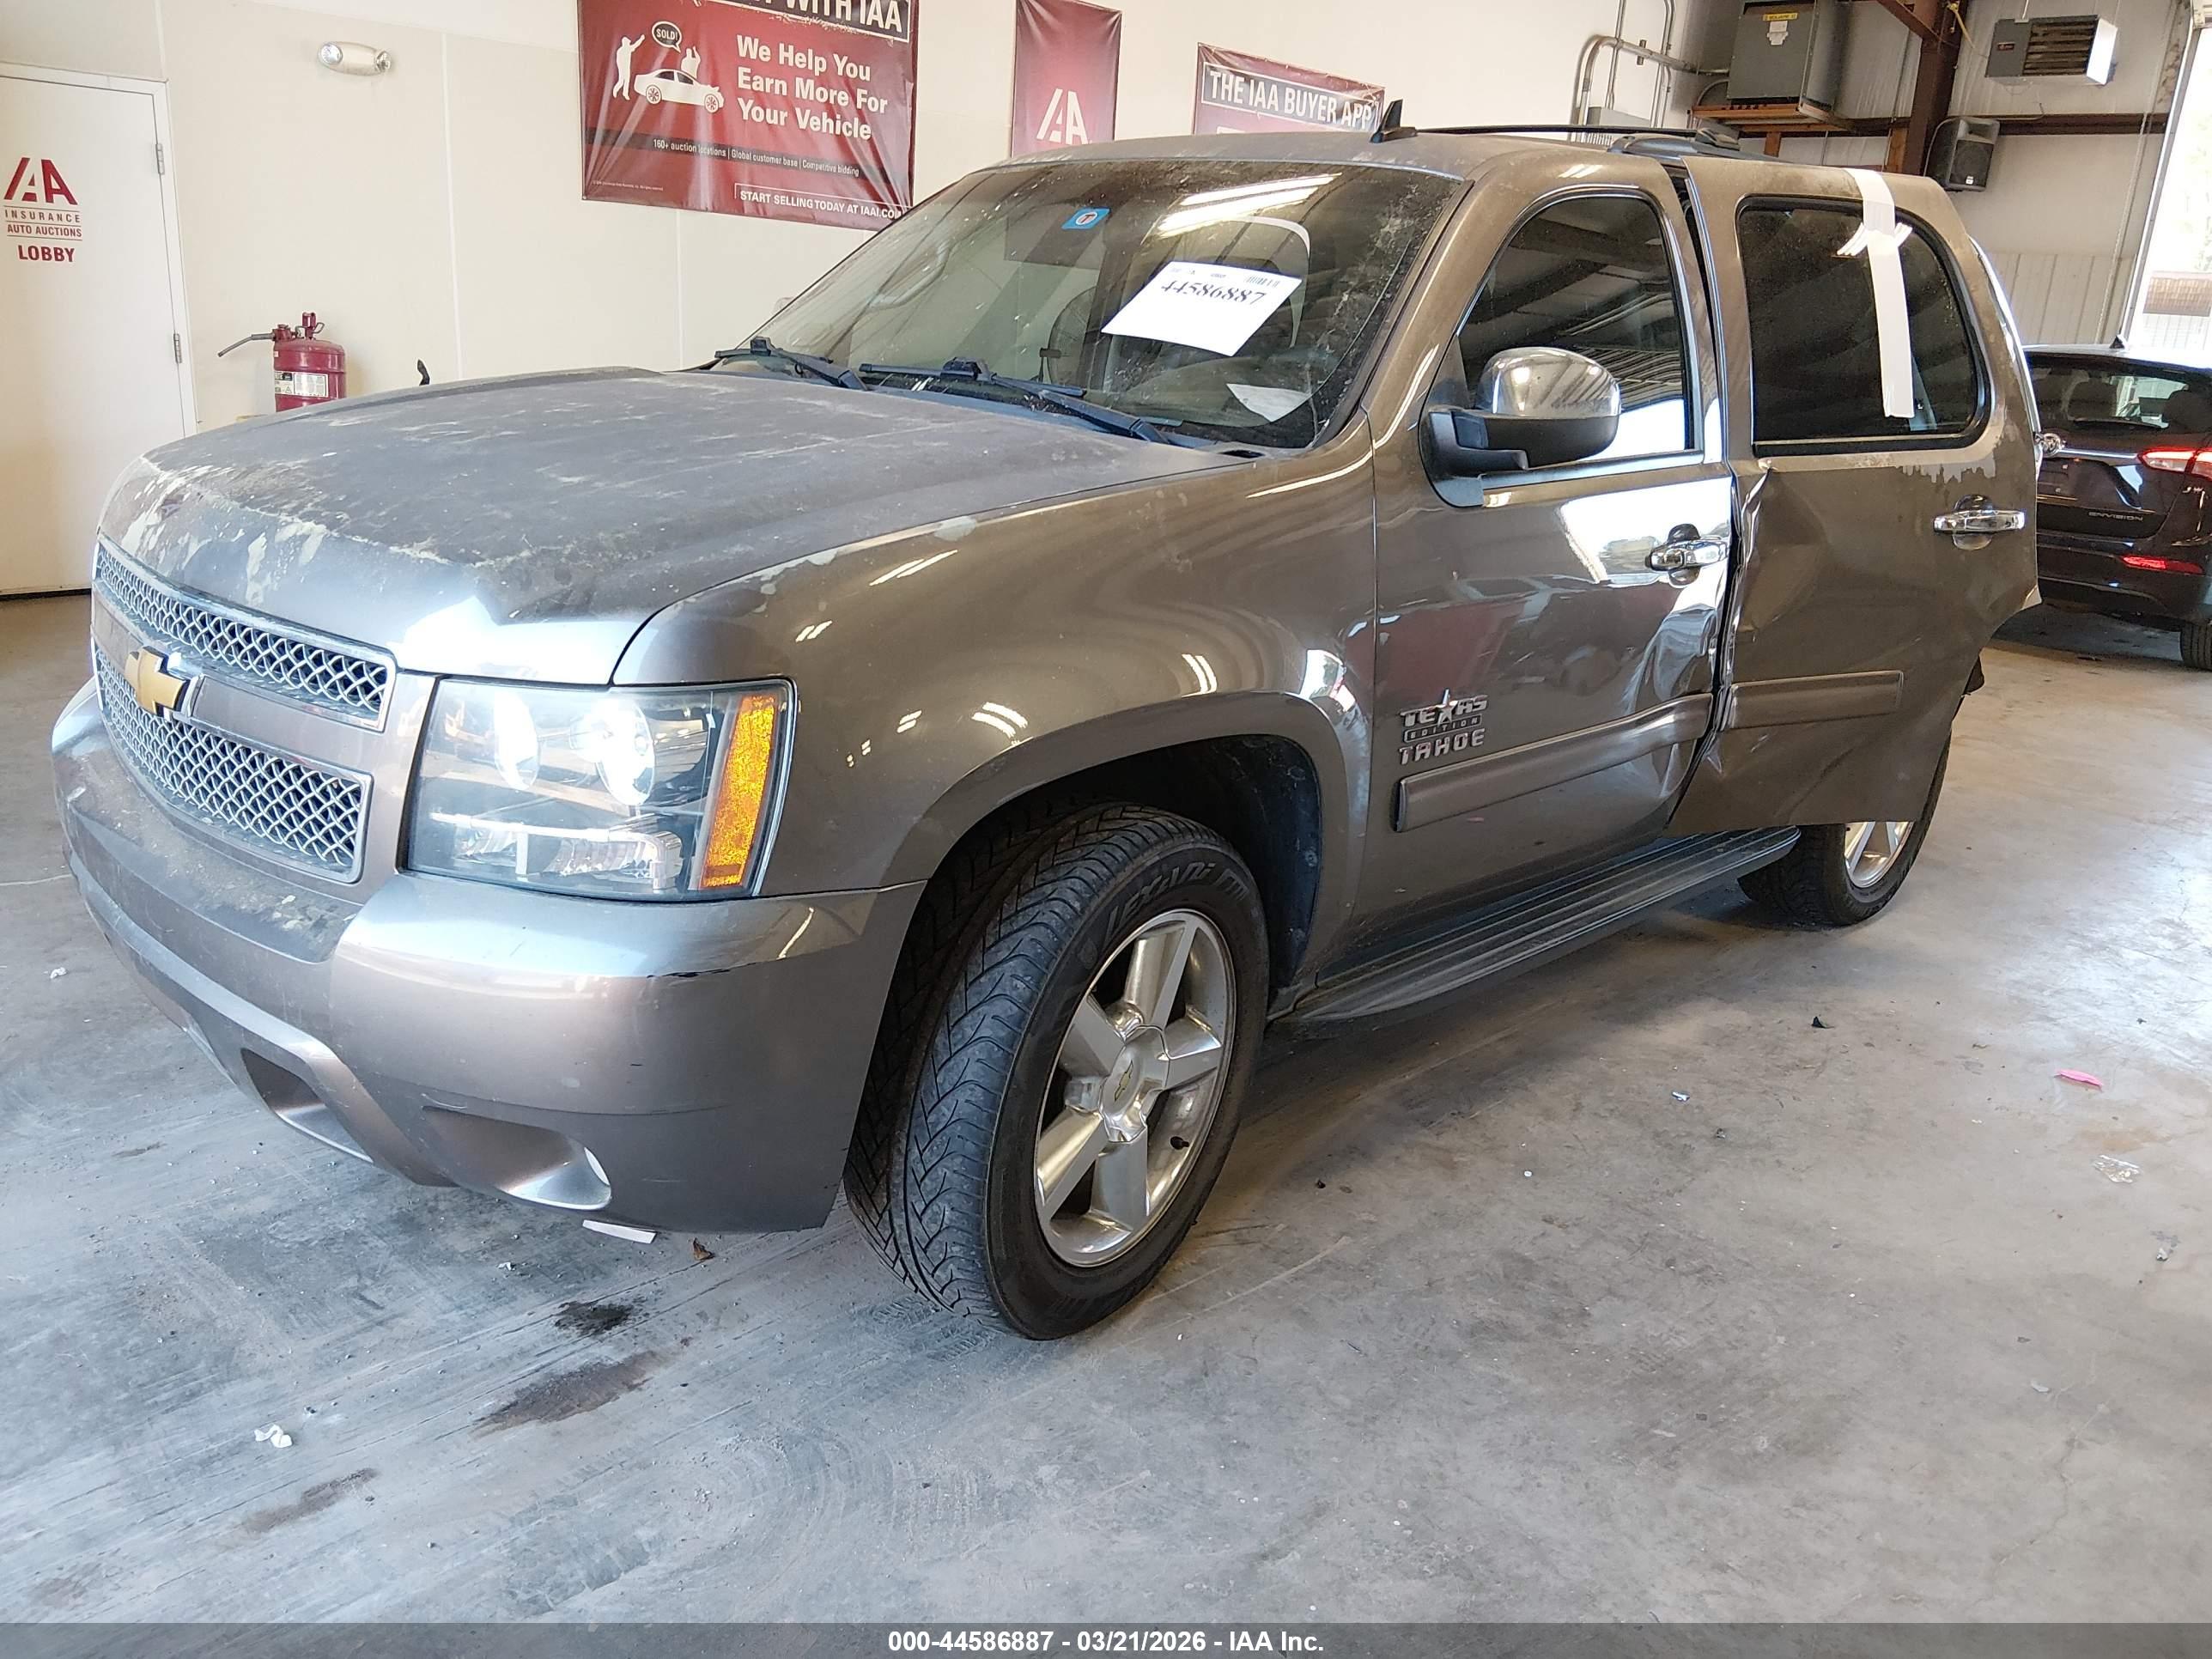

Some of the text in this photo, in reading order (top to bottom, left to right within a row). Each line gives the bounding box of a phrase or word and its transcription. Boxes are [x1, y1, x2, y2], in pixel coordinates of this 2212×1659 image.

[860, 0, 902, 33] IAA
[656, 27, 678, 40] SOLD!
[737, 34, 871, 82] We Help You
[738, 67, 888, 113] Earn More For
[1210, 70, 1372, 129] THE IAA BUYER APP
[738, 97, 871, 140] Your Vehicle
[653, 138, 669, 149] 160+
[671, 142, 696, 153] auction
[698, 145, 726, 157] locations
[732, 150, 751, 161] Global
[753, 154, 781, 165] customer
[783, 157, 798, 167] base
[802, 160, 836, 173] Competitive
[838, 164, 860, 177] bidding
[5, 210, 81, 223] INSURANCE
[740, 190, 771, 204] START
[774, 195, 813, 209] SELLING
[815, 200, 845, 213] TODAY
[847, 204, 858, 214] AT
[8, 224, 82, 238] AUTO AUCTIONS
[18, 245, 75, 263] LOBBY
[1161, 276, 1267, 305] 44586887
[2088, 512, 2143, 521] ENVISION
[1400, 690, 1488, 728] TEXAS
[1410, 717, 1479, 739] EDITION
[1399, 728, 1486, 765] TAHOE
